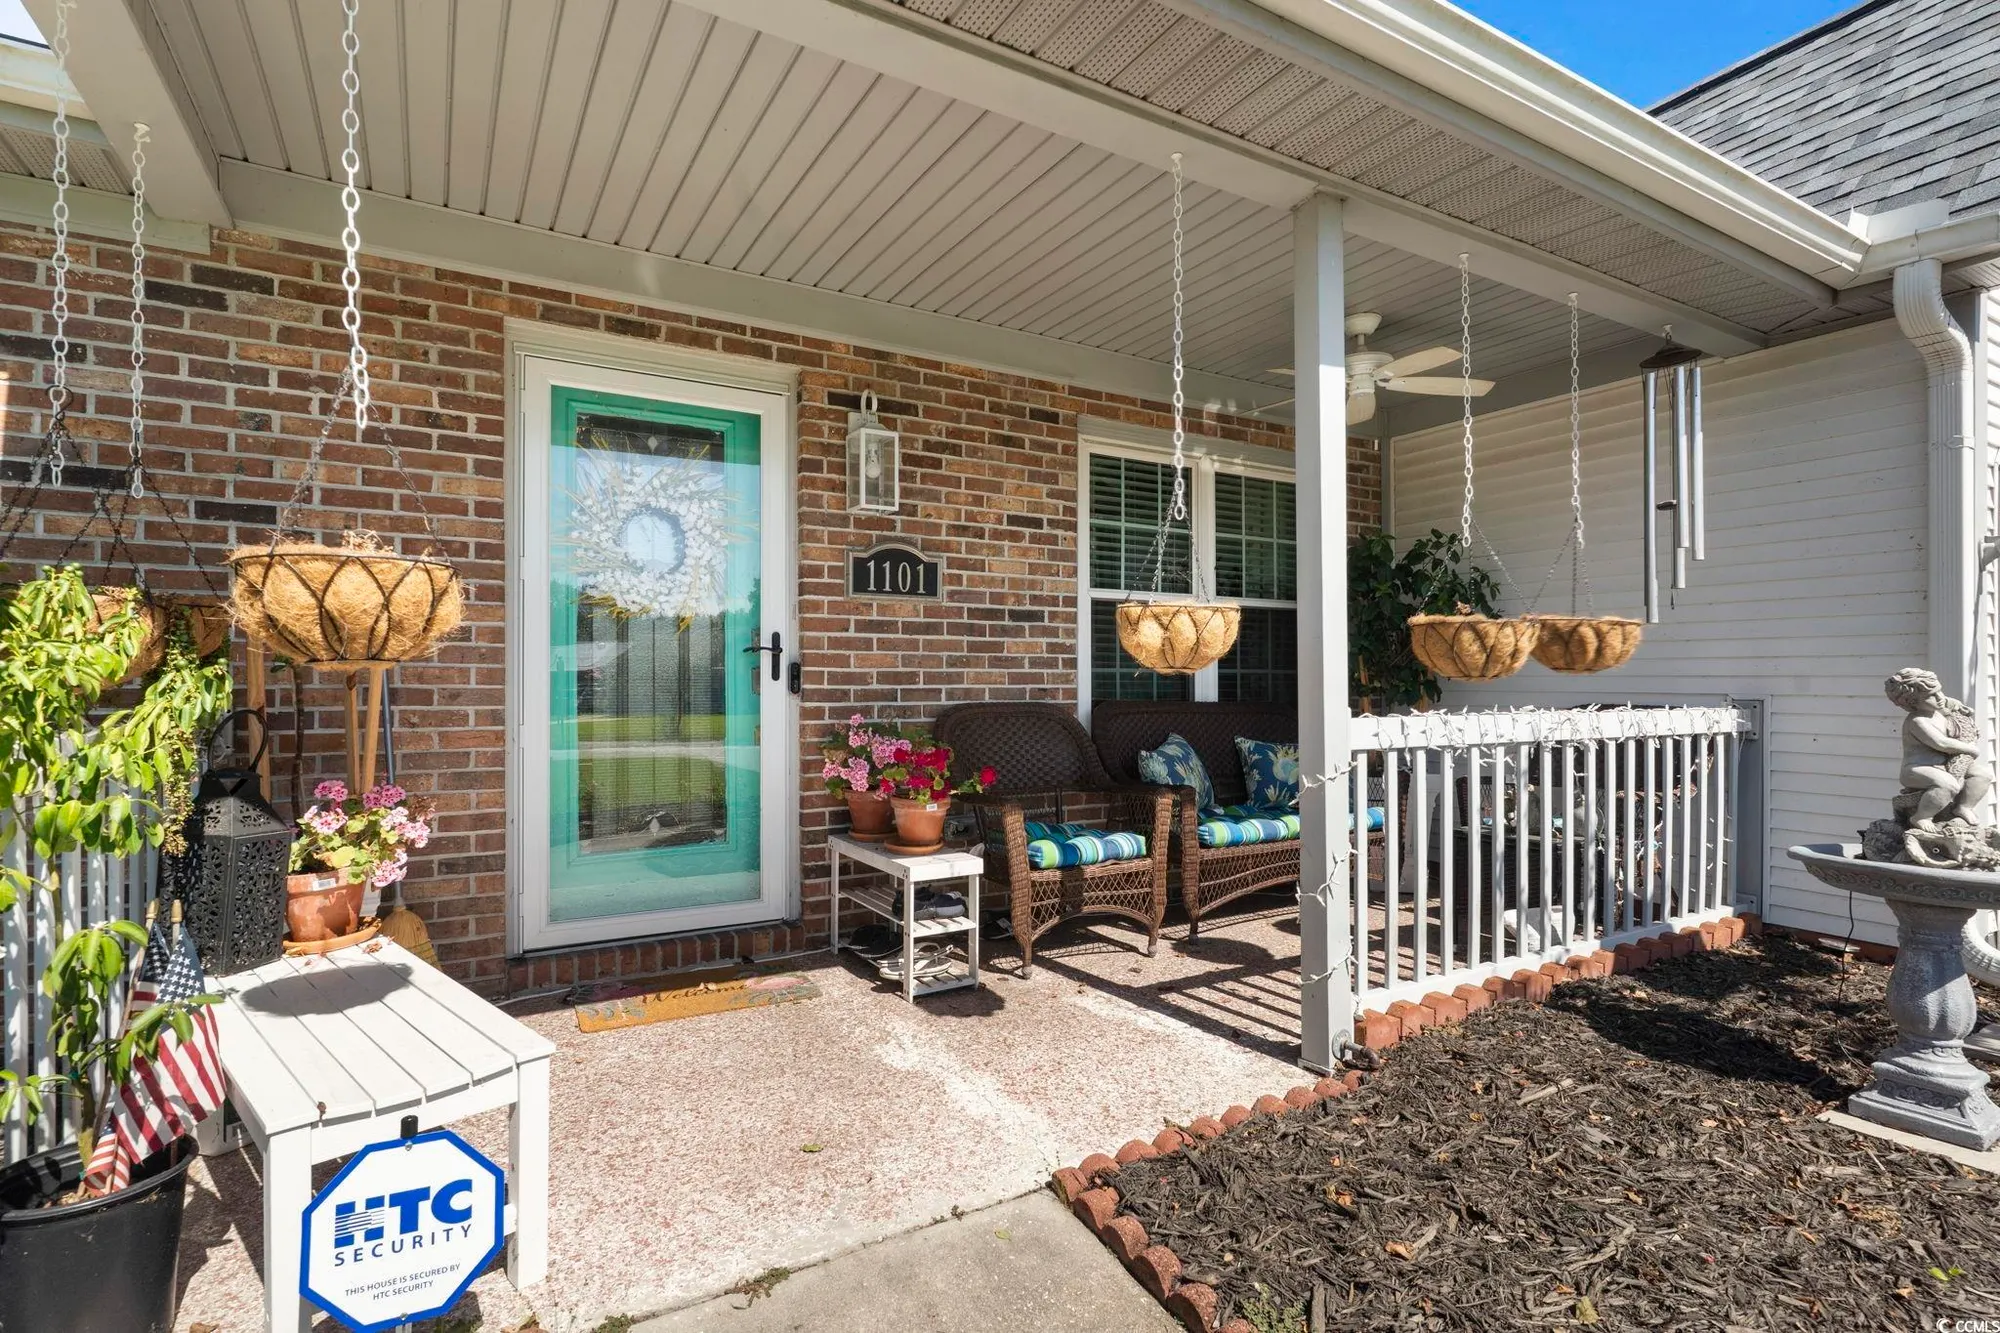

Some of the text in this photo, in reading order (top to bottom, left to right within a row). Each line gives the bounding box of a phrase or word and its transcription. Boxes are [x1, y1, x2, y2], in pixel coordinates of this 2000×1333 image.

[866, 559, 927, 594] 1101
[334, 1178, 473, 1249] HTC
[334, 1223, 472, 1267] SECURITY
[345, 1262, 461, 1297] THIS HOUSE IS SECURED BY
[373, 1280, 434, 1301] HTC SECURITY
